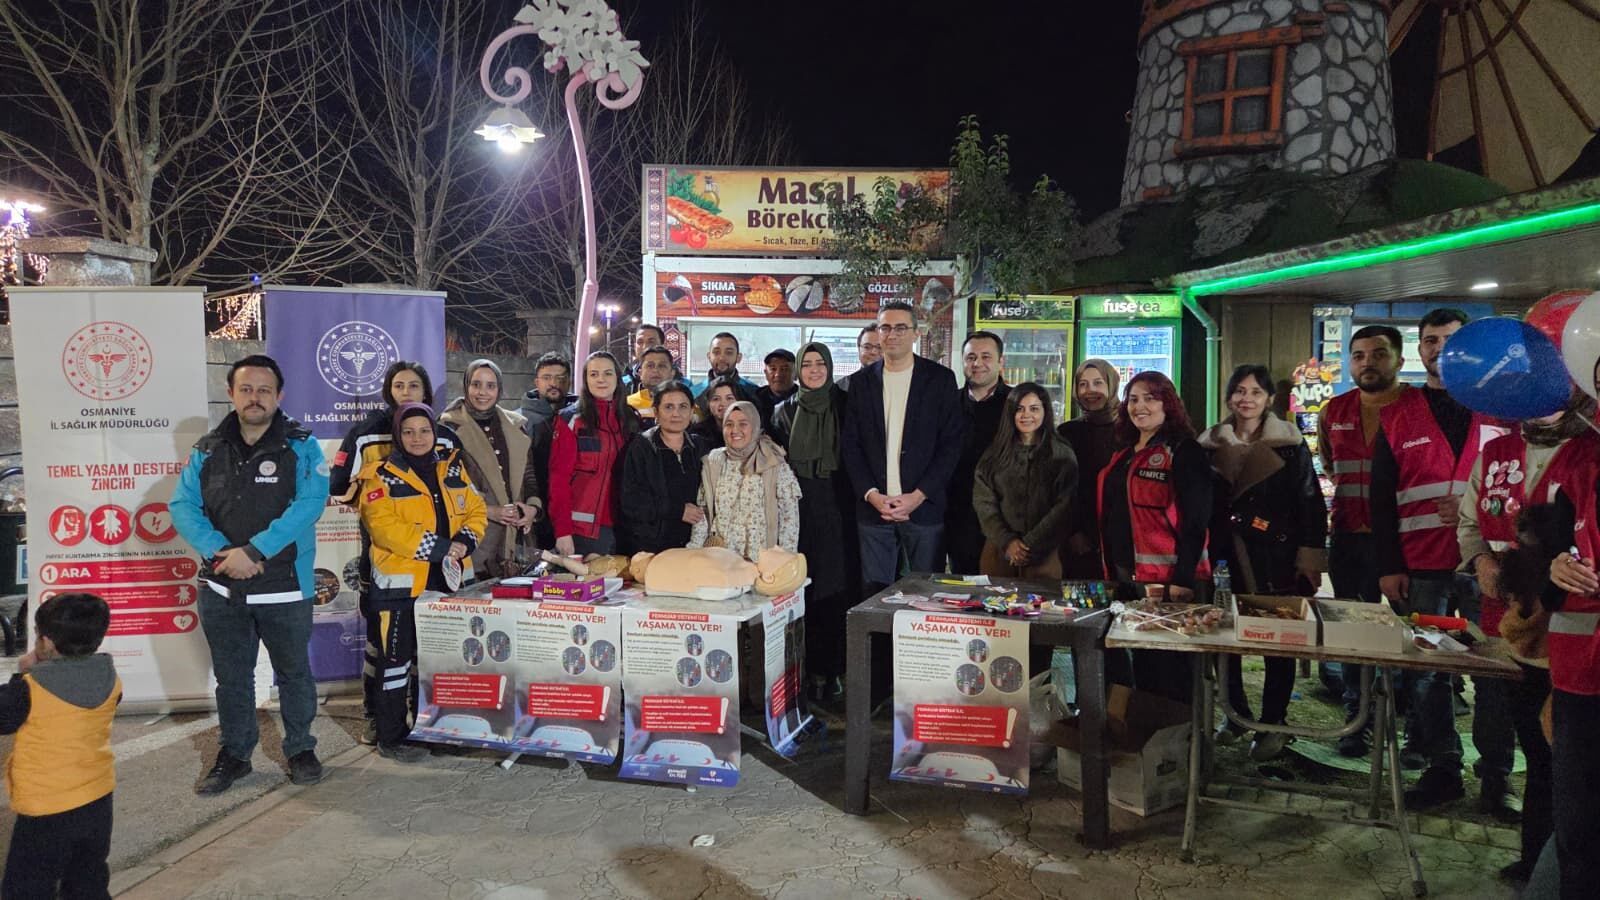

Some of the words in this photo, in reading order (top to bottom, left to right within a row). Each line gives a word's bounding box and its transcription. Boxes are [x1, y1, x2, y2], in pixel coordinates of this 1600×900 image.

[758, 176, 855, 205] Masal
[701, 281, 736, 291] SIKMA
[868, 281, 908, 293] GÖZLE
[701, 292, 737, 305] BÖREK
[80, 406, 136, 417] OSMANİYE
[334, 400, 385, 410] OSMANİYE
[50, 421, 59, 430] İL
[61, 419, 97, 430] SAĞLIK
[100, 417, 169, 429] MÜDÜRLÜĞÜ
[304, 413, 313, 422] İL
[315, 412, 350, 422] SAĞLIK
[351, 412, 368, 422] MÜ
[47, 465, 83, 478] TEMEL
[60, 567, 91, 578] ARA
[543, 587, 565, 595] hobby
[427, 603, 462, 613] YAŞAMA
[464, 605, 480, 614] YOL
[482, 606, 501, 616] VER!
[526, 610, 563, 621] YAŞAMA
[565, 613, 583, 622] YOL
[585, 615, 606, 624] VER!
[636, 620, 676, 631] YAŞAMA
[678, 622, 698, 631] YOL
[700, 623, 722, 633] VER!
[910, 622, 957, 635] YAŞAMA
[960, 625, 982, 636] YOL
[985, 627, 1011, 639] VER!
